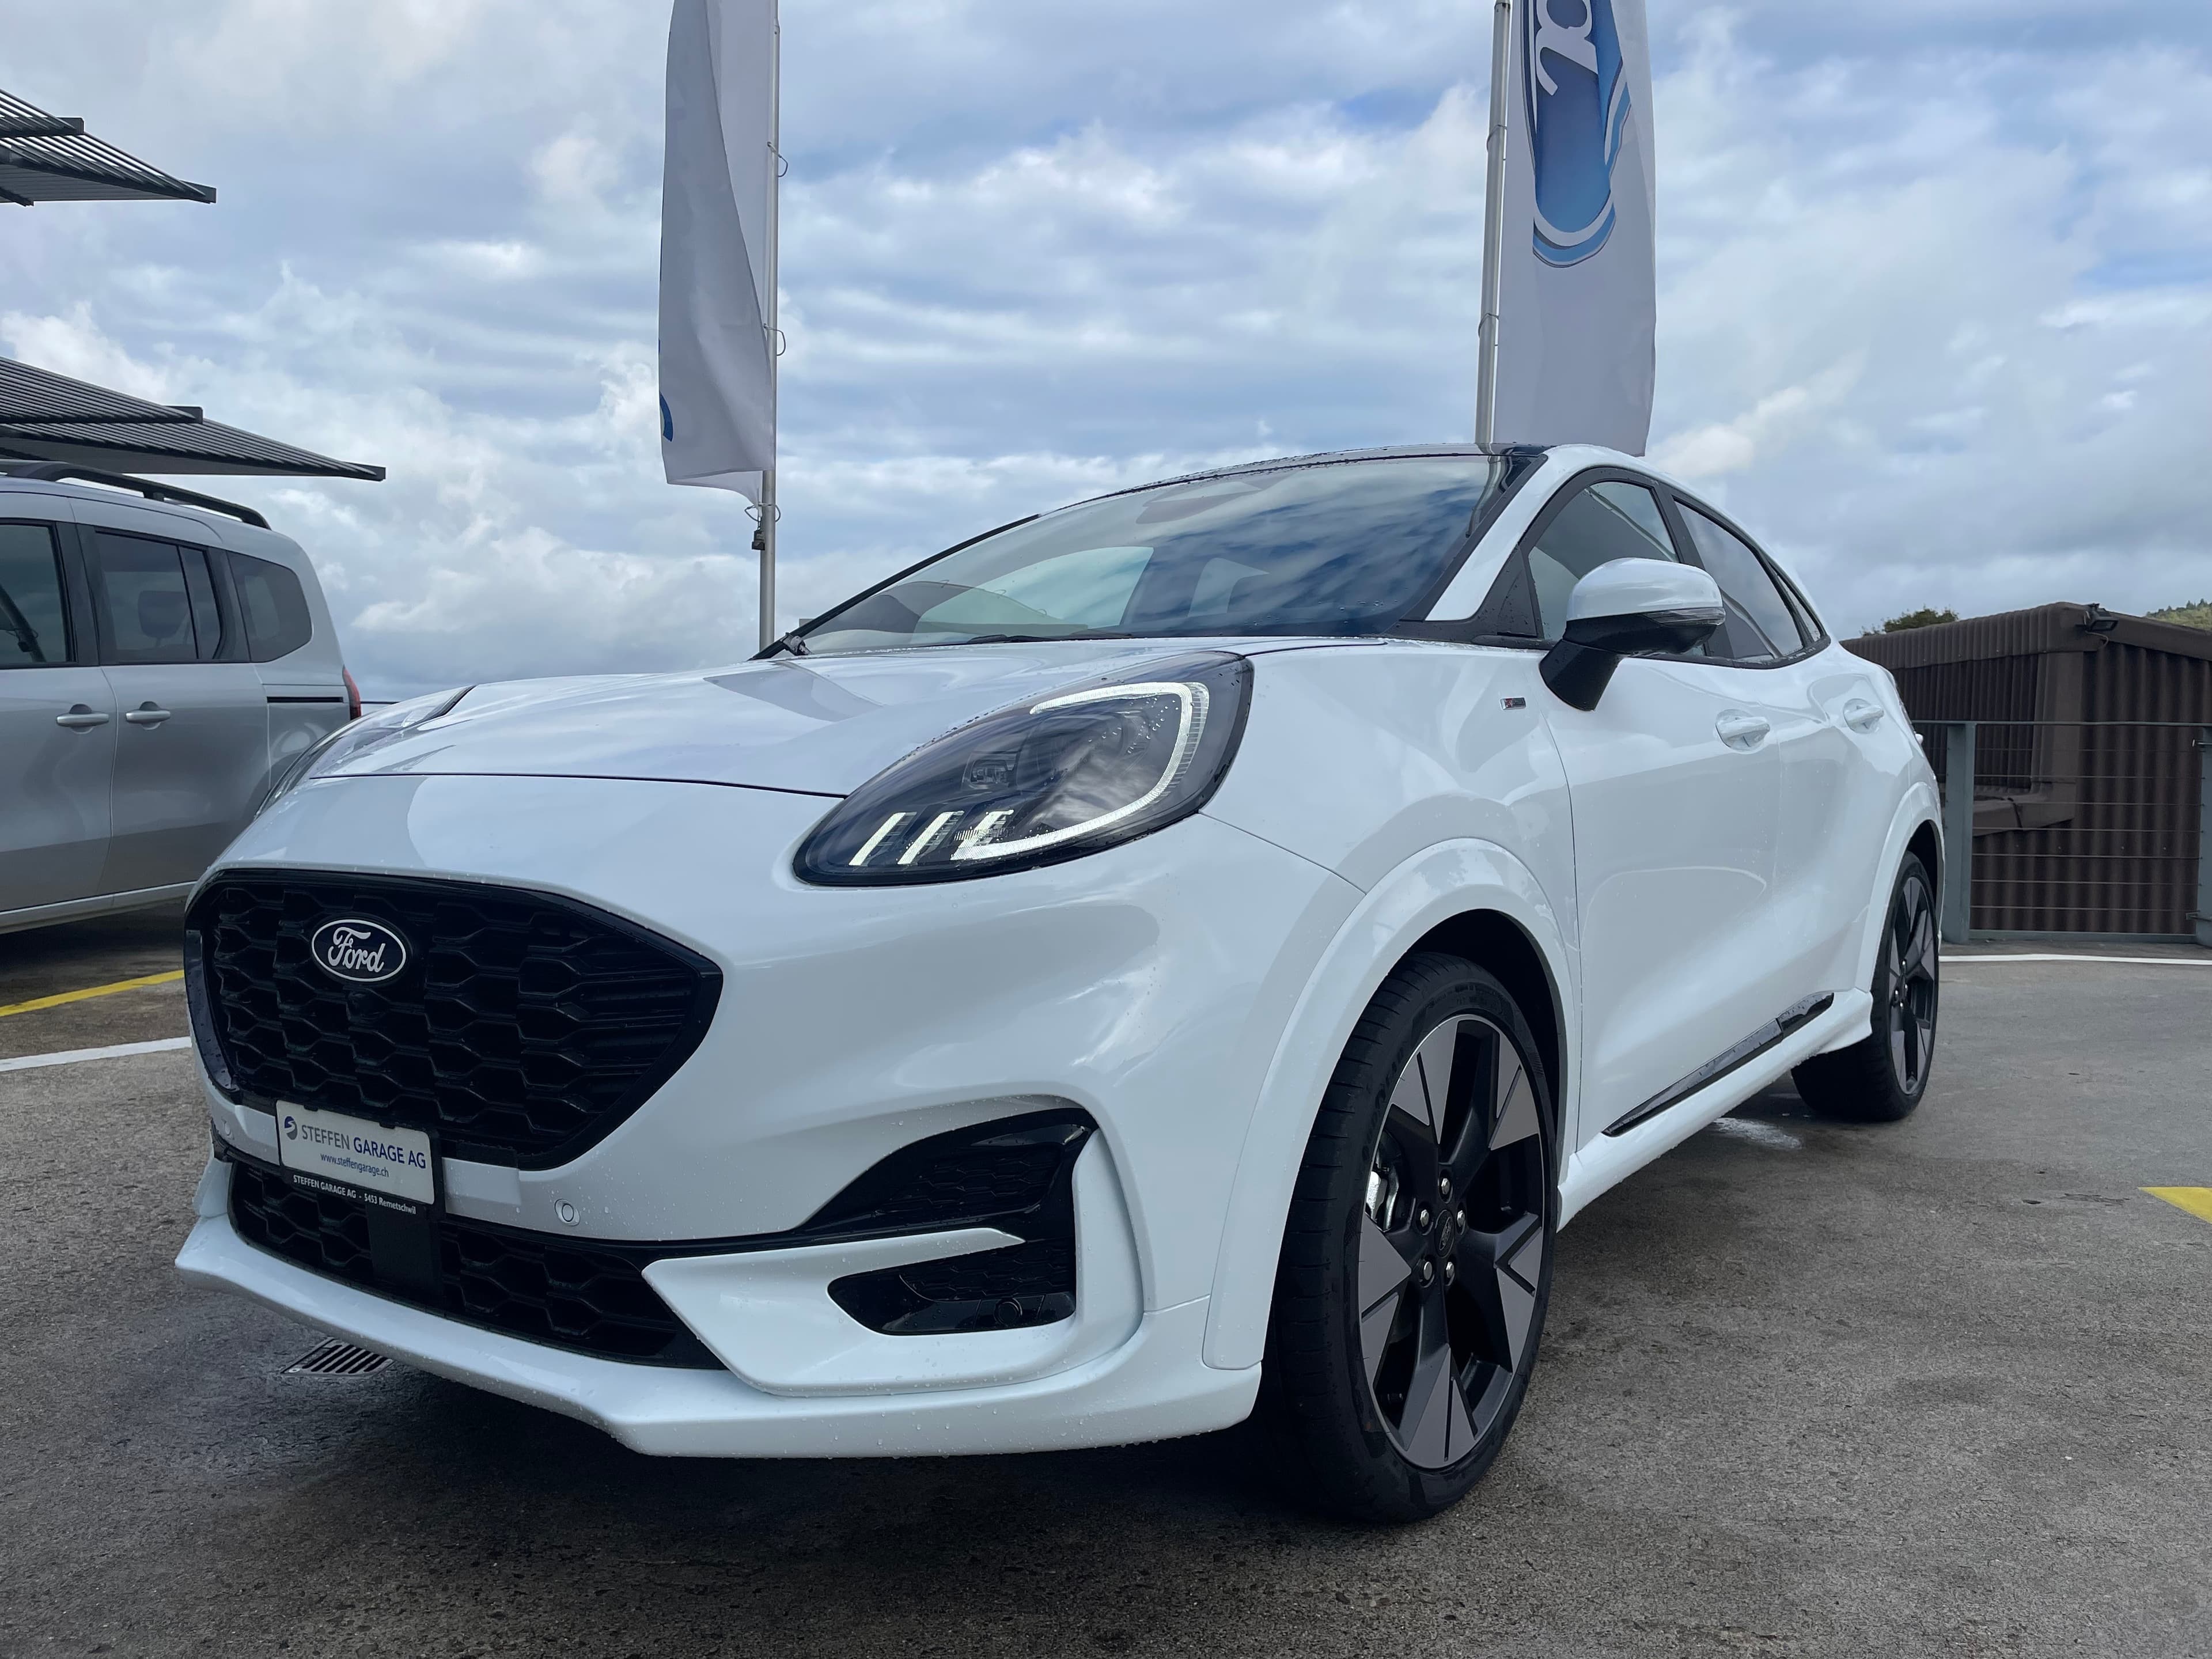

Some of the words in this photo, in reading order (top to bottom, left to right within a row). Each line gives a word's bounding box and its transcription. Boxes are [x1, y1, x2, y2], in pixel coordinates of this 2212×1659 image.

[328, 926, 386, 972] Ford
[301, 1124, 350, 1150] STEFFEN
[354, 1137, 405, 1164] GARAGE
[408, 1150, 426, 1169] AG
[320, 1153, 389, 1177] www.steffengarage.ch
[293, 1175, 319, 1189] STEFFEN
[320, 1181, 346, 1196] GARAGE
[347, 1188, 357, 1199] AG
[364, 1193, 378, 1205] 5453
[378, 1197, 416, 1215] Remetschwil
